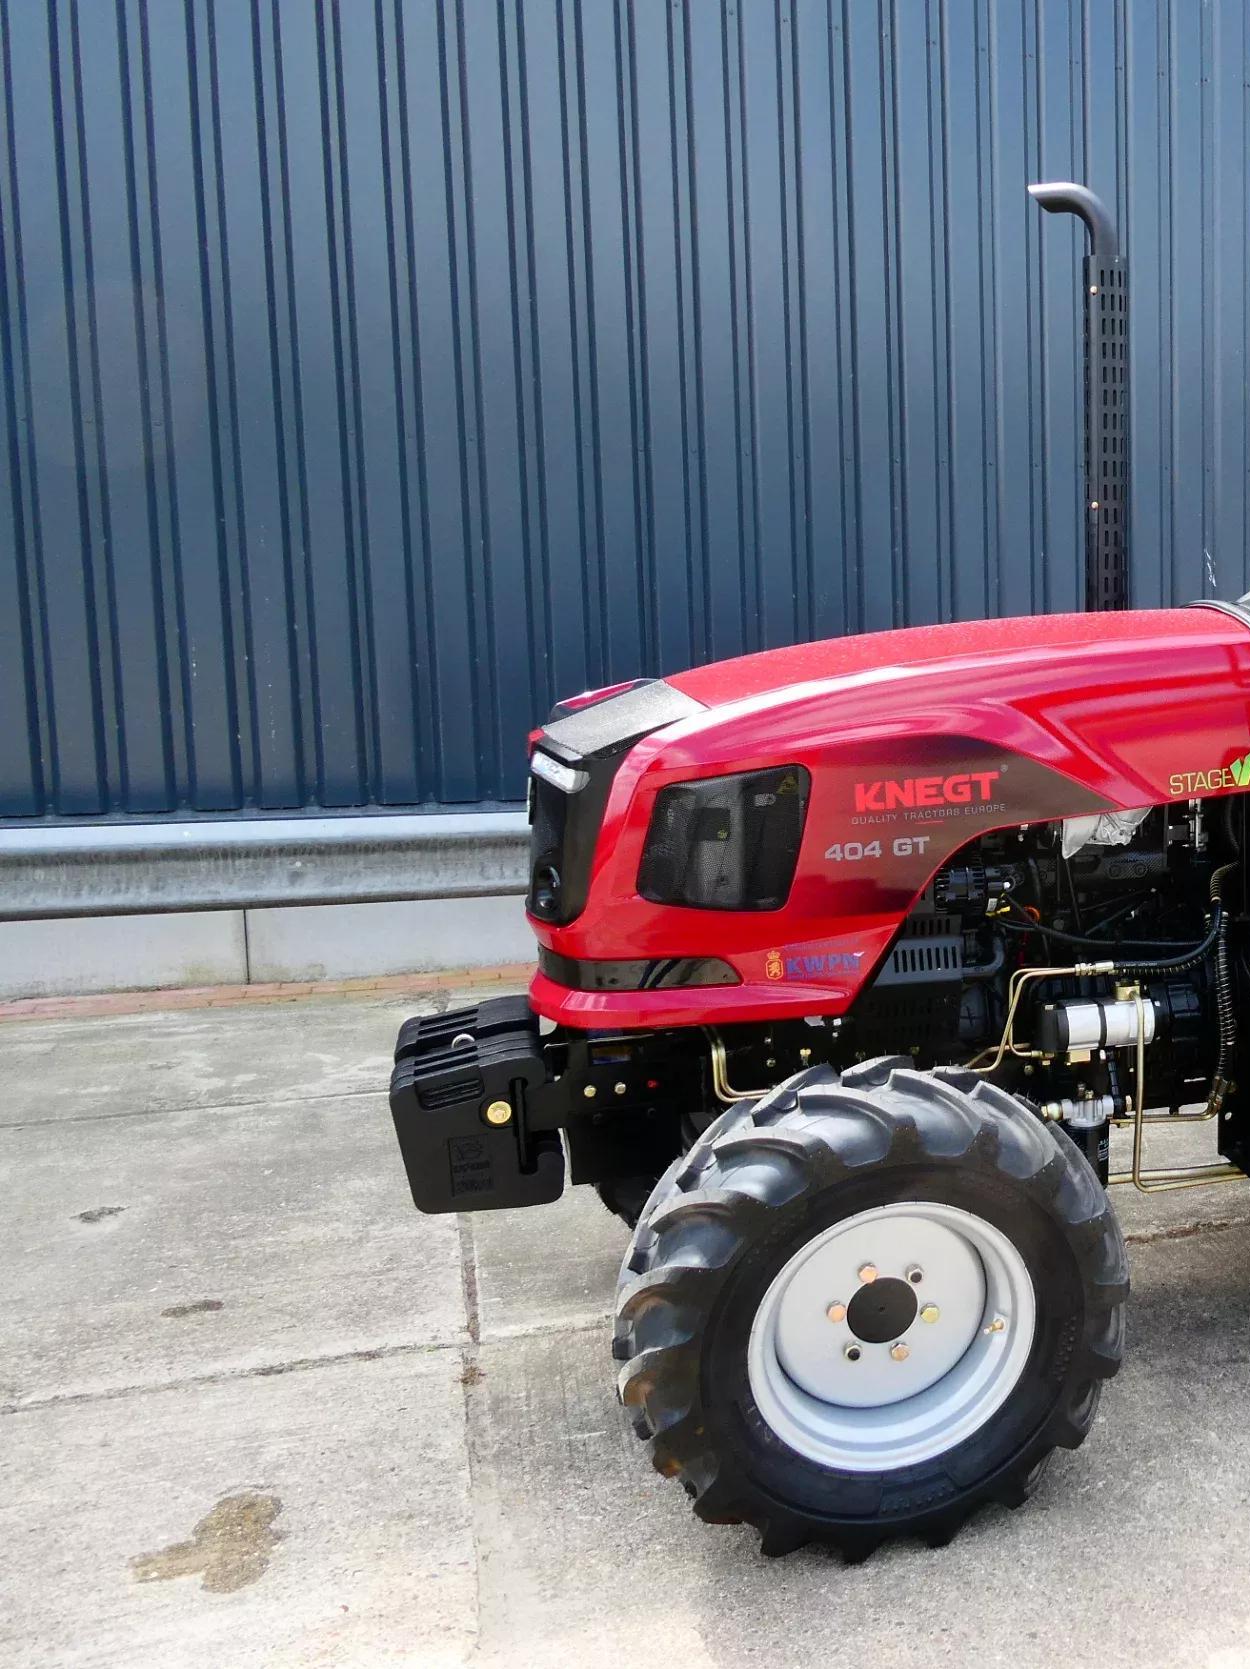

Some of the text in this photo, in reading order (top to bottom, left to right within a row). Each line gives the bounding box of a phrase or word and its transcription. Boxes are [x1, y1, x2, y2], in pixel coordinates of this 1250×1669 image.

[854, 771, 999, 812] KNEGT
[1169, 768, 1235, 795] STAGE
[851, 803, 1006, 825] QUALITY TRACTORS EUROPE
[824, 835, 930, 861] 404 GT
